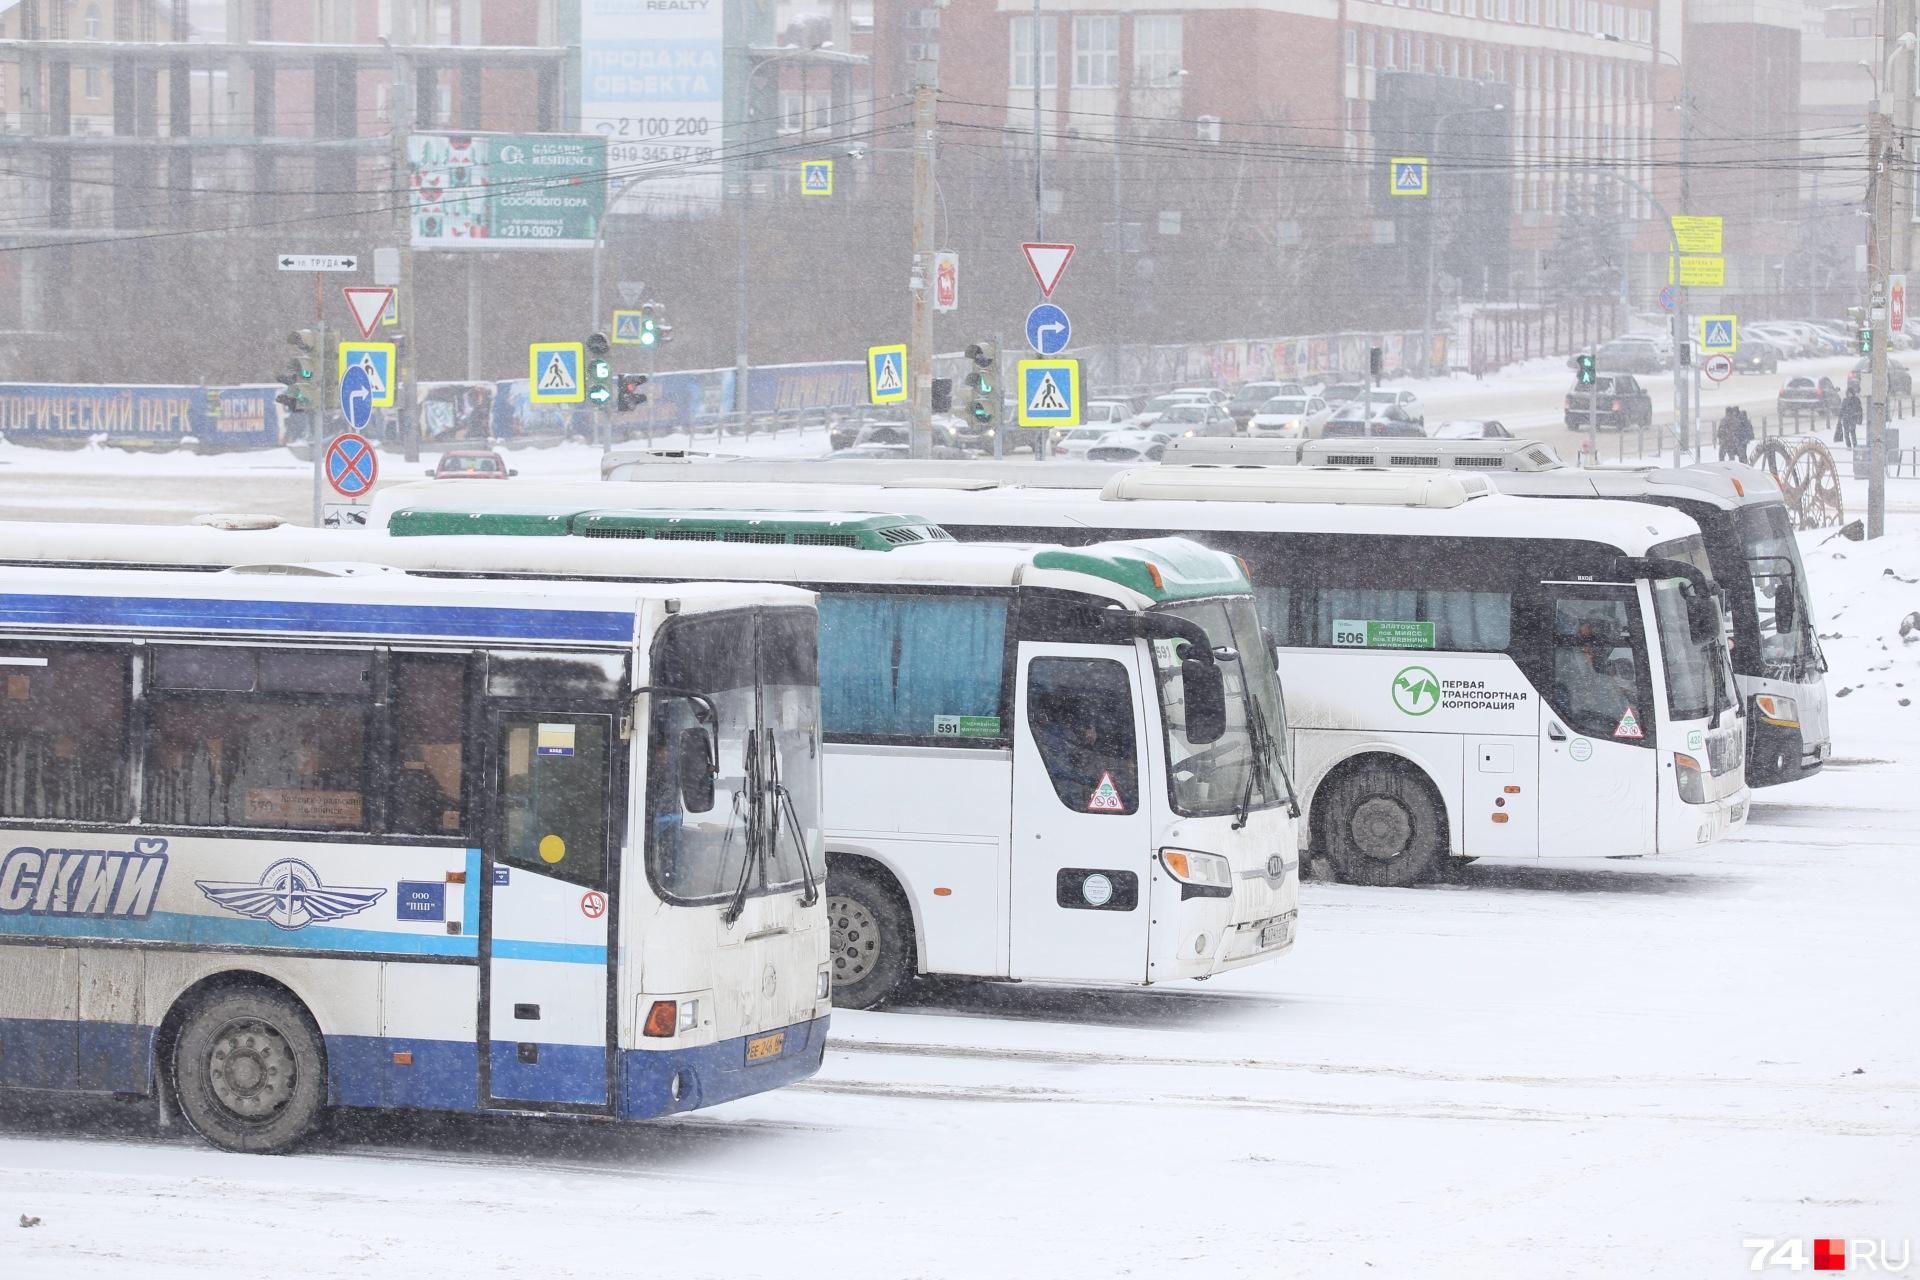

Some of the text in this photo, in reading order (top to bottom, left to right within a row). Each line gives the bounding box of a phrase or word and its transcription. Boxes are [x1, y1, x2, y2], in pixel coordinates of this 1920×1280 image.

[646, 0, 709, 10] REALTY
[588, 50, 716, 69] ПРОДАЖА
[594, 75, 710, 93] ОБЪЕКТА
[619, 117, 708, 136] 2 100 200
[611, 147, 638, 161] 919
[642, 147, 668, 161] 345
[673, 147, 690, 161] 67
[532, 156, 594, 166] RESIDENCE
[501, 197, 589, 206] СОСНОВОГО БОРА
[507, 225, 564, 237] 219-000-7
[312, 259, 339, 267] ТРУДА
[139, 398, 193, 432] ПАРК
[1337, 632, 1364, 644] 506
[1154, 645, 1172, 659] 591
[1442, 680, 1485, 689] ПЕРВАЯ
[1442, 690, 1528, 701] ТРАНСПОРТНАЯ
[1442, 700, 1516, 710] КОРПОРАЦИЯ
[937, 723, 957, 734] 591
[0, 837, 169, 921] СКИЙ
[412, 891, 430, 900] ООО
